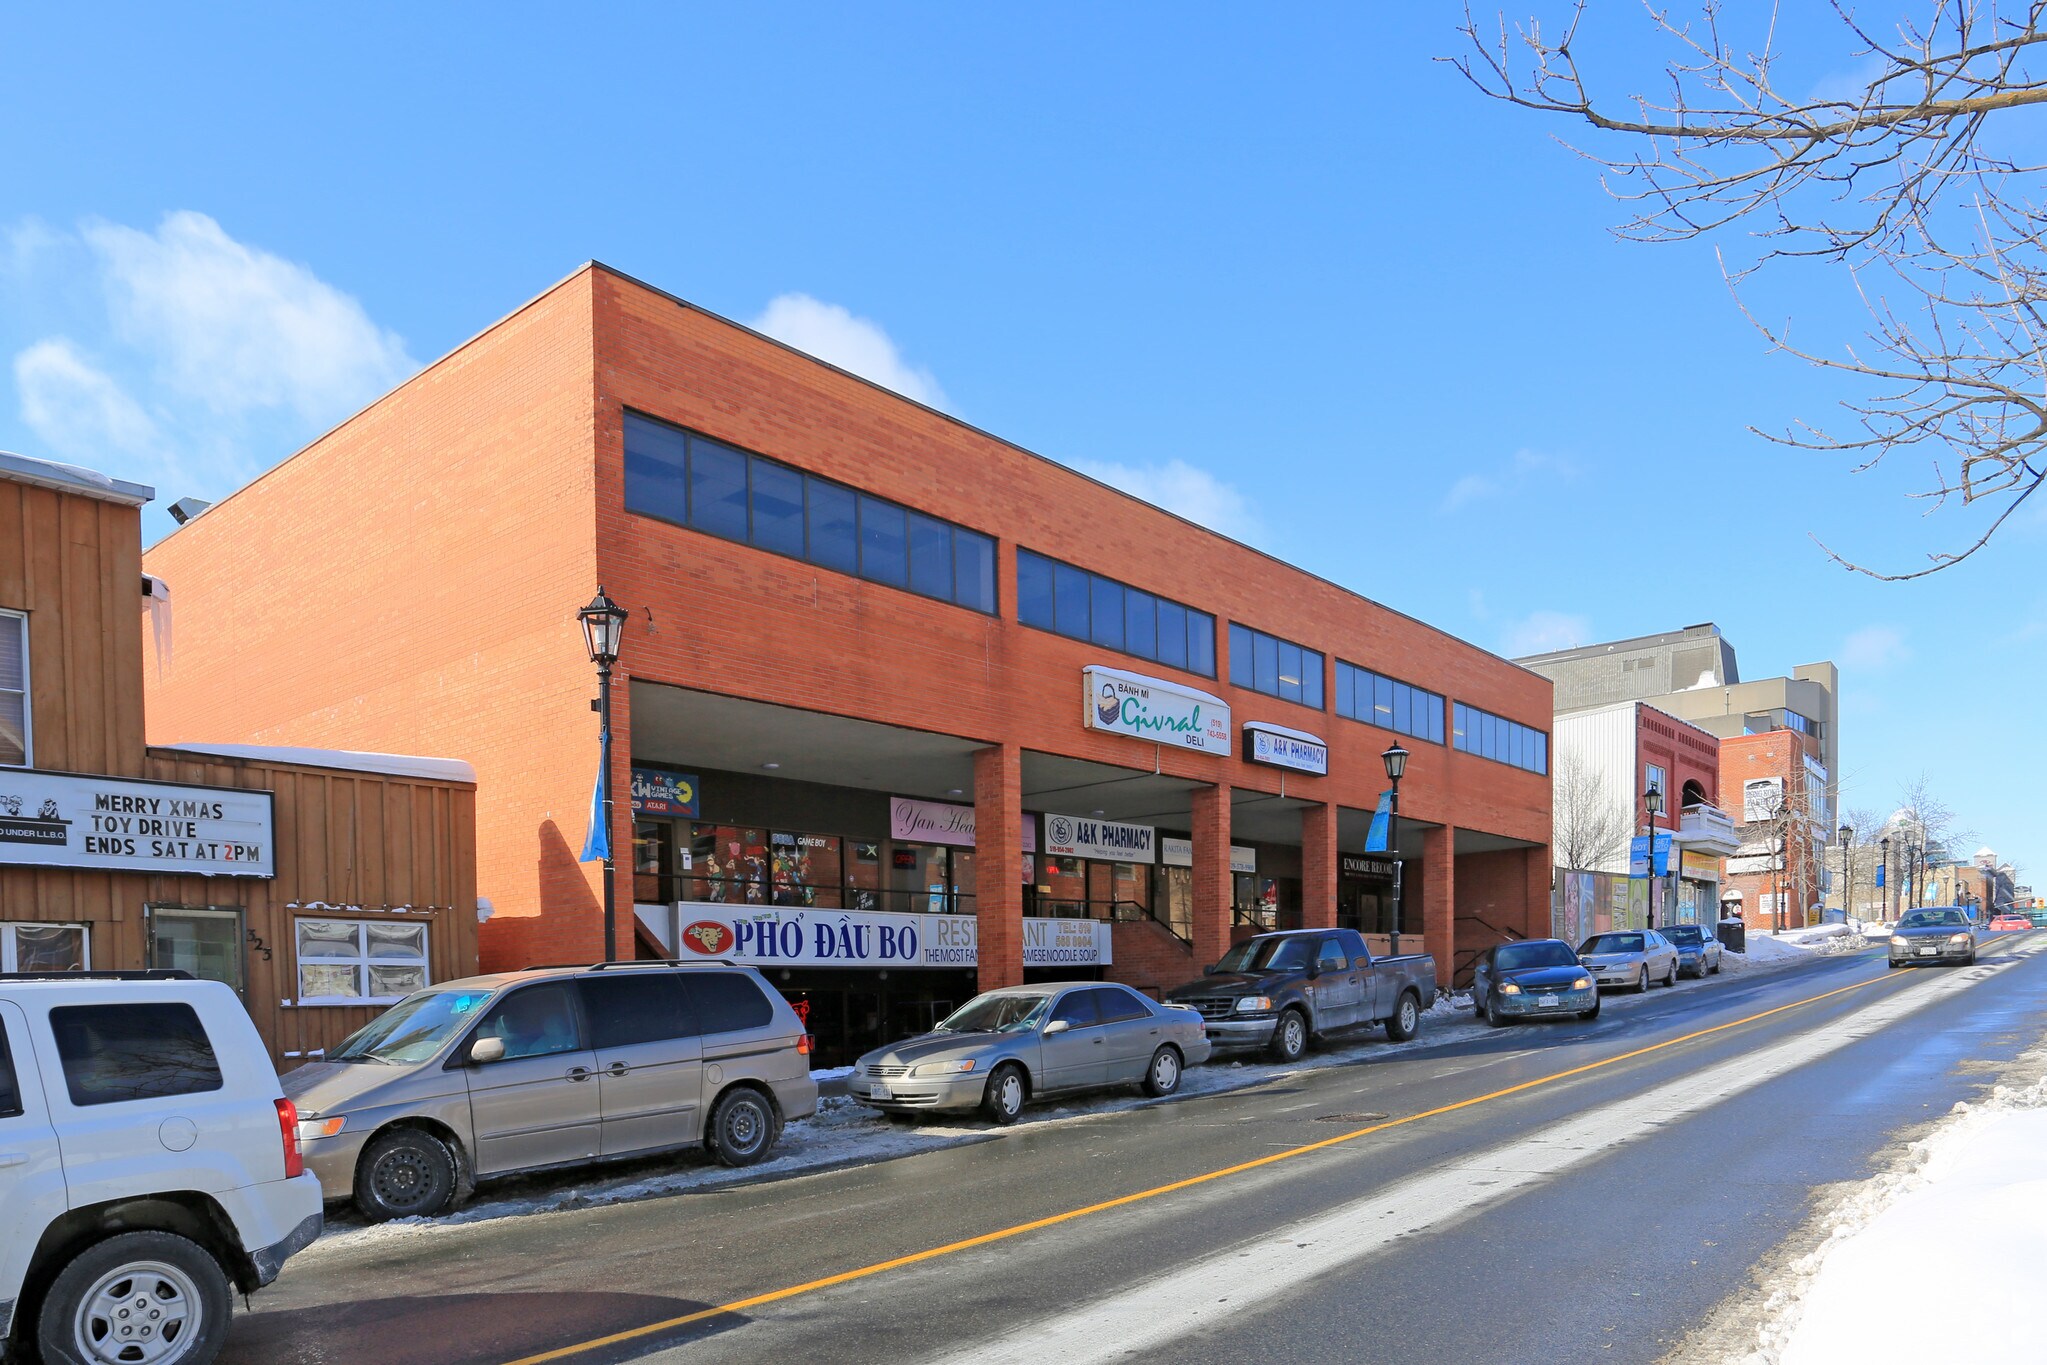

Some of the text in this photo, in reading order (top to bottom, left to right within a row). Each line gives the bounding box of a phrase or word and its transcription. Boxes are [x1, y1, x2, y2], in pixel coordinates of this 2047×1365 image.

[1121, 697, 1203, 732] Givral
[1185, 734, 1205, 747] DELI
[1273, 738, 1288, 757] A&K
[1290, 742, 1325, 765] PHARMACY
[650, 785, 683, 795] VINTAGE
[650, 791, 674, 800] GAMES
[95, 793, 223, 820] MERRY XMAS
[646, 801, 667, 810] ATARI
[896, 801, 935, 836] Yan
[6, 828, 35, 837] UNDER
[91, 815, 197, 838] TOY DRIVE
[797, 836, 814, 847] GAME
[814, 838, 827, 848] BOY
[1076, 821, 1151, 851] A&K PHARMACY
[1655, 837, 1670, 845] GET
[85, 836, 260, 862] ENDS SAT AT 2PM
[1631, 843, 1648, 852] HOT
[1343, 857, 1371, 873] ENCORE
[1056, 921, 1092, 935] TEL: 519
[247, 928, 272, 961] 323
[878, 920, 918, 960] BÒ
[924, 948, 940, 963] THE
[940, 948, 964, 963] MOST
[1046, 949, 1078, 962] NOODLE
[1079, 949, 1098, 962] SOUP
